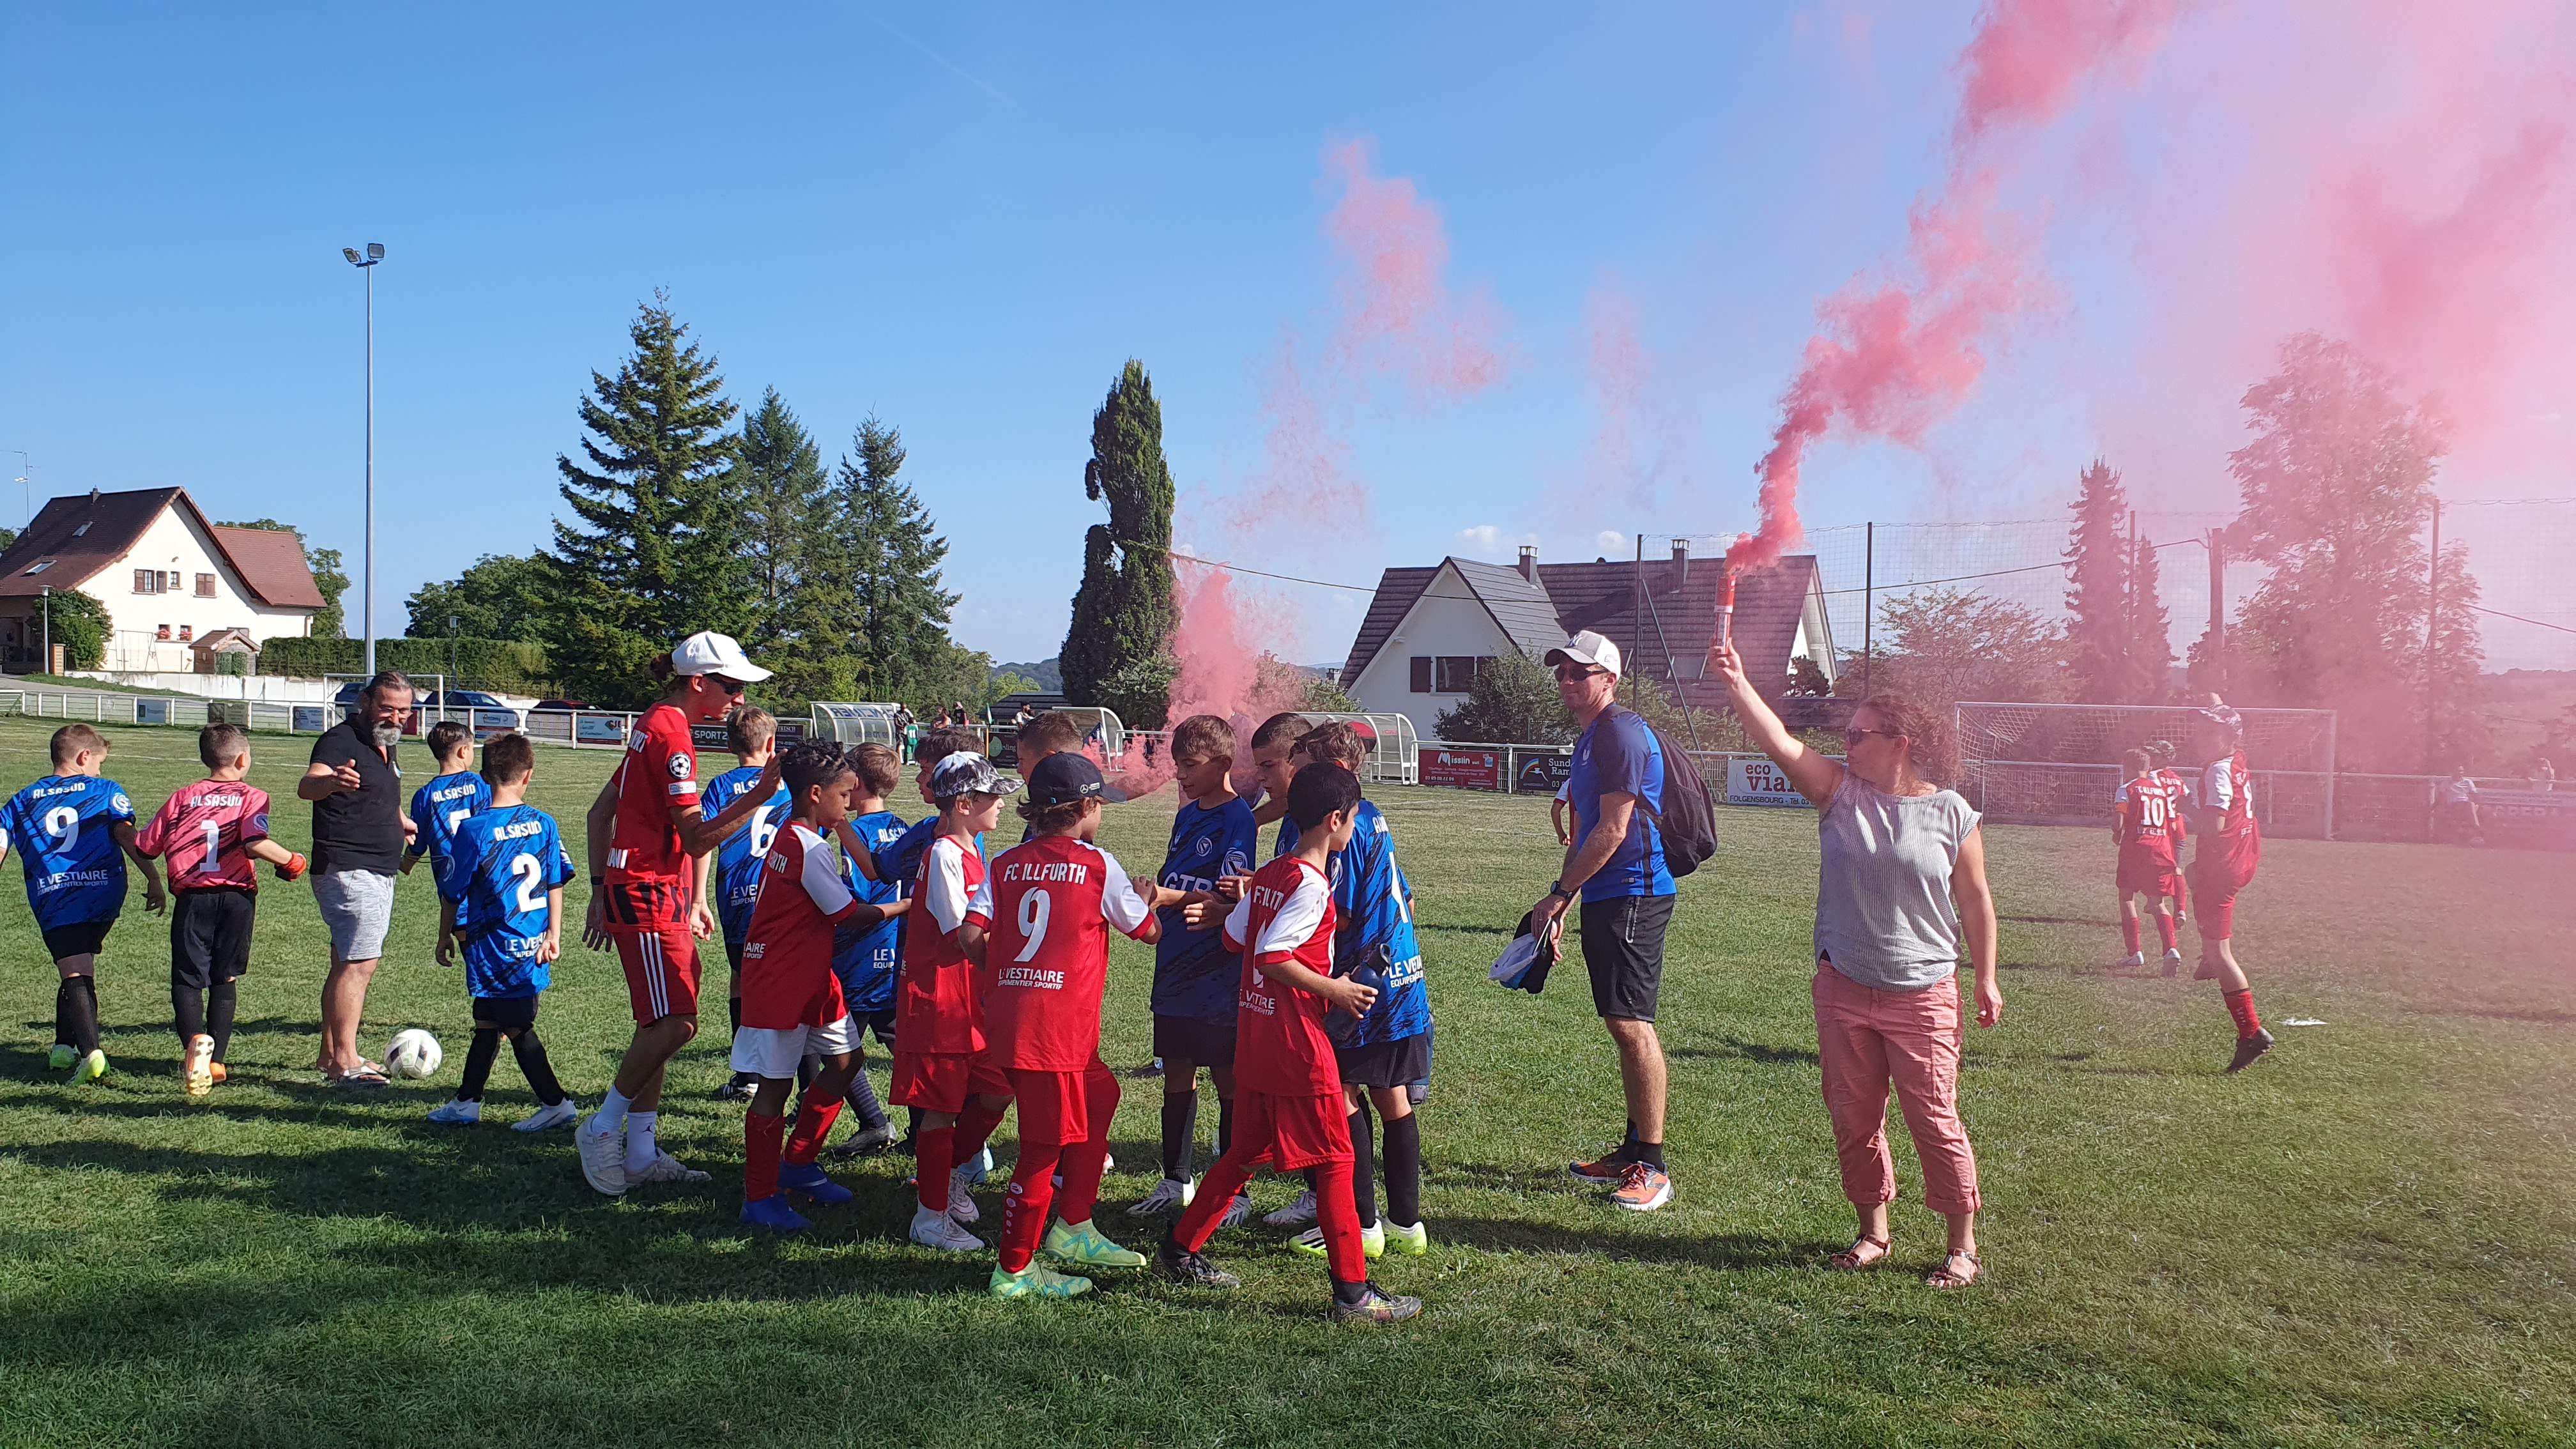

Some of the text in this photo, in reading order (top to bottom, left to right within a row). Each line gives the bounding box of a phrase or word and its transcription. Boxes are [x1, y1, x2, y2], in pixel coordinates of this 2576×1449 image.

[908, 730, 916, 739] 11
[1438, 752, 1470, 767] Misslin
[1745, 764, 1771, 775] eco
[33, 782, 86, 799] ALSASUD
[433, 783, 476, 802] ALSASUD
[190, 795, 242, 808] ALSASUD
[1729, 795, 1783, 804] FOLGENSBOURG
[2140, 795, 2165, 827] 10
[45, 806, 79, 853] 9
[494, 820, 542, 841] ALSASUD
[751, 805, 779, 858] 6
[199, 820, 221, 873] 1
[47, 869, 109, 884] VESTIAIRE
[1004, 862, 1087, 885] FC ILLFURTH
[512, 852, 548, 913] 2
[1013, 886, 1051, 962] 9
[504, 939, 518, 951] LE
[874, 949, 889, 961] LE
[1006, 967, 1065, 983] VESTIAIRE
[1389, 962, 1404, 979] LE
[1034, 981, 1063, 990] SPORTIF
